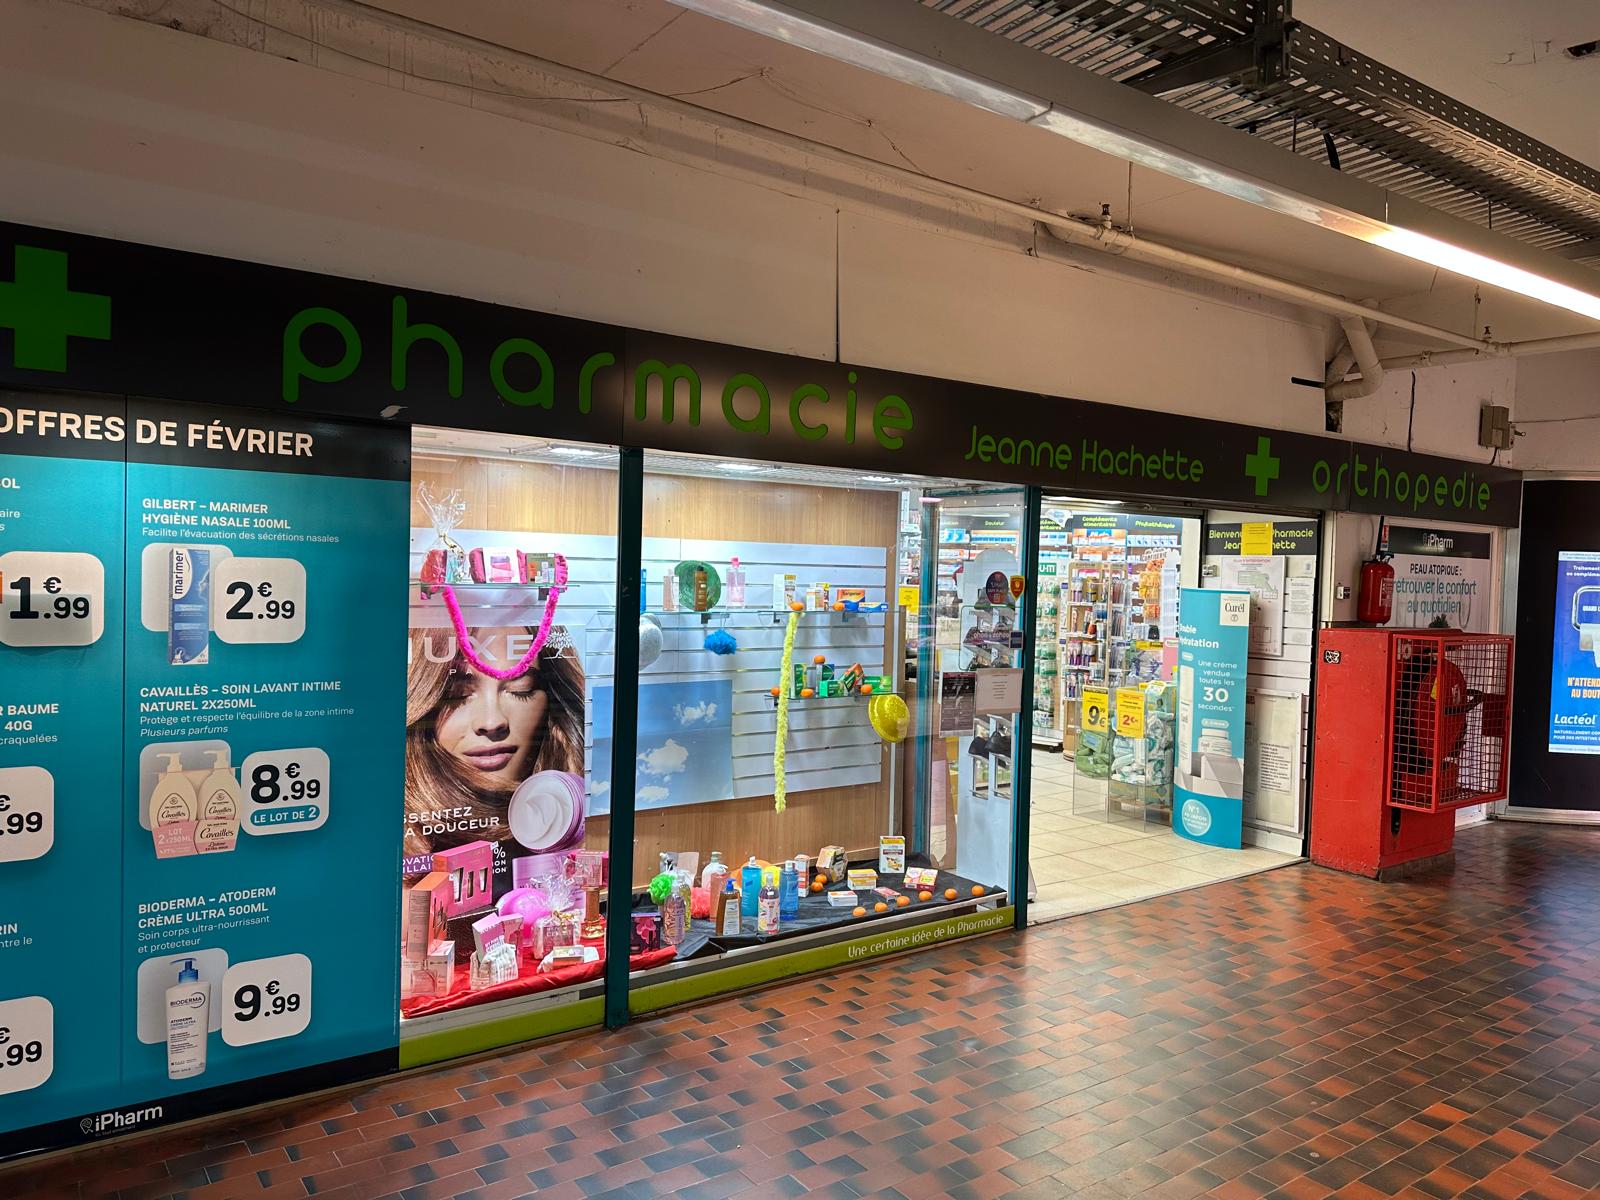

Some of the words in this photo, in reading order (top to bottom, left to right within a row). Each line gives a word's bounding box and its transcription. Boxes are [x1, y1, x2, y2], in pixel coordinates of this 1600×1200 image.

[282, 295, 914, 450] pharmacie
[0, 406, 125, 442] OFFRES
[136, 419, 177, 446] DE
[187, 418, 313, 457] FÉVRIER
[964, 425, 1072, 470] Jeanne
[1081, 439, 1204, 482] Hachette
[0, 477, 20, 489] OL
[1312, 455, 1490, 512] orthopedie
[142, 498, 196, 510] GILBERT
[209, 501, 268, 514] MARIMER
[142, 512, 198, 525] HYGIÈNE
[201, 516, 250, 528] NASALE
[253, 519, 291, 529] 100ML
[142, 528, 177, 537] Facilite
[239, 531, 255, 540] des
[258, 532, 304, 542] sécrétions
[306, 534, 339, 543] nasales
[1427, 533, 1454, 549] iPharm
[174, 551, 184, 594] marimer
[1410, 563, 1427, 574] PEAU
[1428, 564, 1459, 575] ATOPIQUE
[1437, 578, 1444, 594] le
[1446, 579, 1476, 595] confort
[1407, 600, 1418, 613] au
[1421, 596, 1461, 617] quotidien
[408, 634, 533, 664] UXE
[1203, 668, 1230, 677] vendue
[1213, 660, 1238, 669] crème
[140, 683, 208, 698] CAVAILLÈS
[221, 684, 250, 695] SOIN
[253, 682, 299, 694] LAVANT
[302, 681, 341, 692] INTIME
[1199, 676, 1222, 685] toutes
[1223, 677, 1235, 686] les
[1203, 686, 1229, 703] 30
[7, 703, 59, 716] BAUME
[140, 700, 198, 713] NATUREL
[201, 698, 256, 710] 2X250ML
[140, 715, 178, 726] Protège
[181, 714, 190, 723] et
[193, 713, 233, 724] respecte
[282, 709, 293, 718] de
[295, 708, 302, 717] la
[304, 709, 325, 717] zone
[327, 707, 354, 716] intime
[1554, 712, 1597, 725] Lactéol
[4, 720, 33, 731] 40G
[140, 727, 185, 737] Plusieurs
[188, 725, 228, 736] parfums
[254, 814, 266, 823] LE
[270, 812, 289, 822] LOT
[292, 811, 305, 820] DE
[308, 807, 317, 818] 2
[422, 816, 500, 836] DOUCEUR
[138, 896, 206, 914] BIODERMA
[218, 886, 276, 904] ATODERM
[138, 913, 183, 929] CRÈME
[186, 908, 225, 922] ULTRA
[228, 902, 268, 916] 500ML
[138, 931, 160, 941] Soin
[162, 928, 189, 939] corps
[192, 915, 270, 933] ultra-nourrissant
[848, 945, 867, 958] Une
[870, 936, 910, 953] certaine
[912, 932, 932, 944] idée
[933, 927, 945, 938] de
[947, 924, 955, 935] la
[957, 914, 1004, 933] Pharmacie
[23, 936, 33, 945] le
[138, 944, 147, 954] et
[150, 938, 201, 953] protecteur
[170, 996, 203, 1007] BIODERMA
[95, 1106, 163, 1131] iPharm
